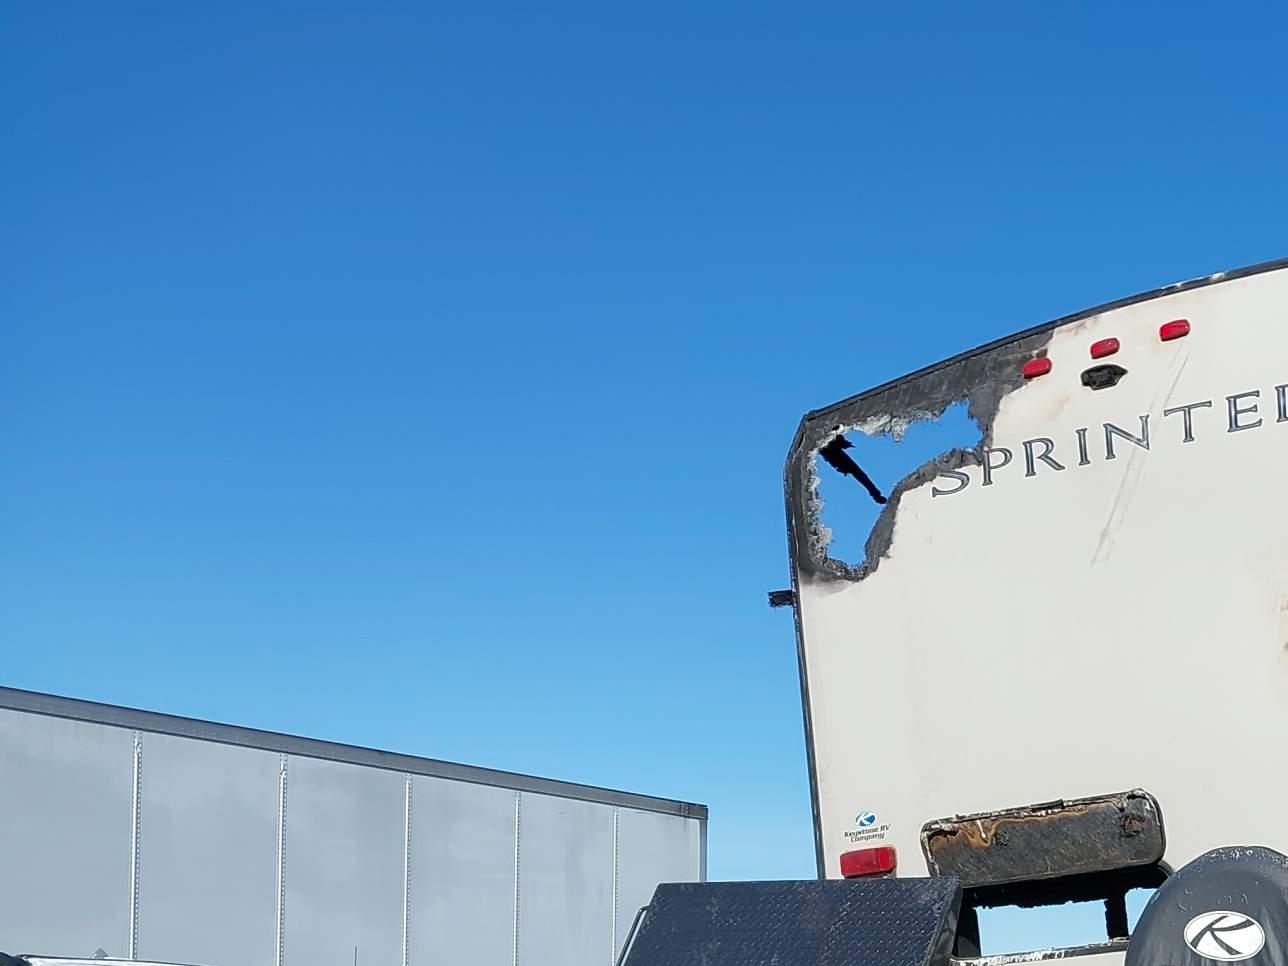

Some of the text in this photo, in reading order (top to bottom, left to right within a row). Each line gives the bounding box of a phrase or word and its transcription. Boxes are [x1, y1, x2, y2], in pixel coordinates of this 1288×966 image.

[844, 824, 891, 838] Keystone RV
[850, 832, 885, 843] Company
